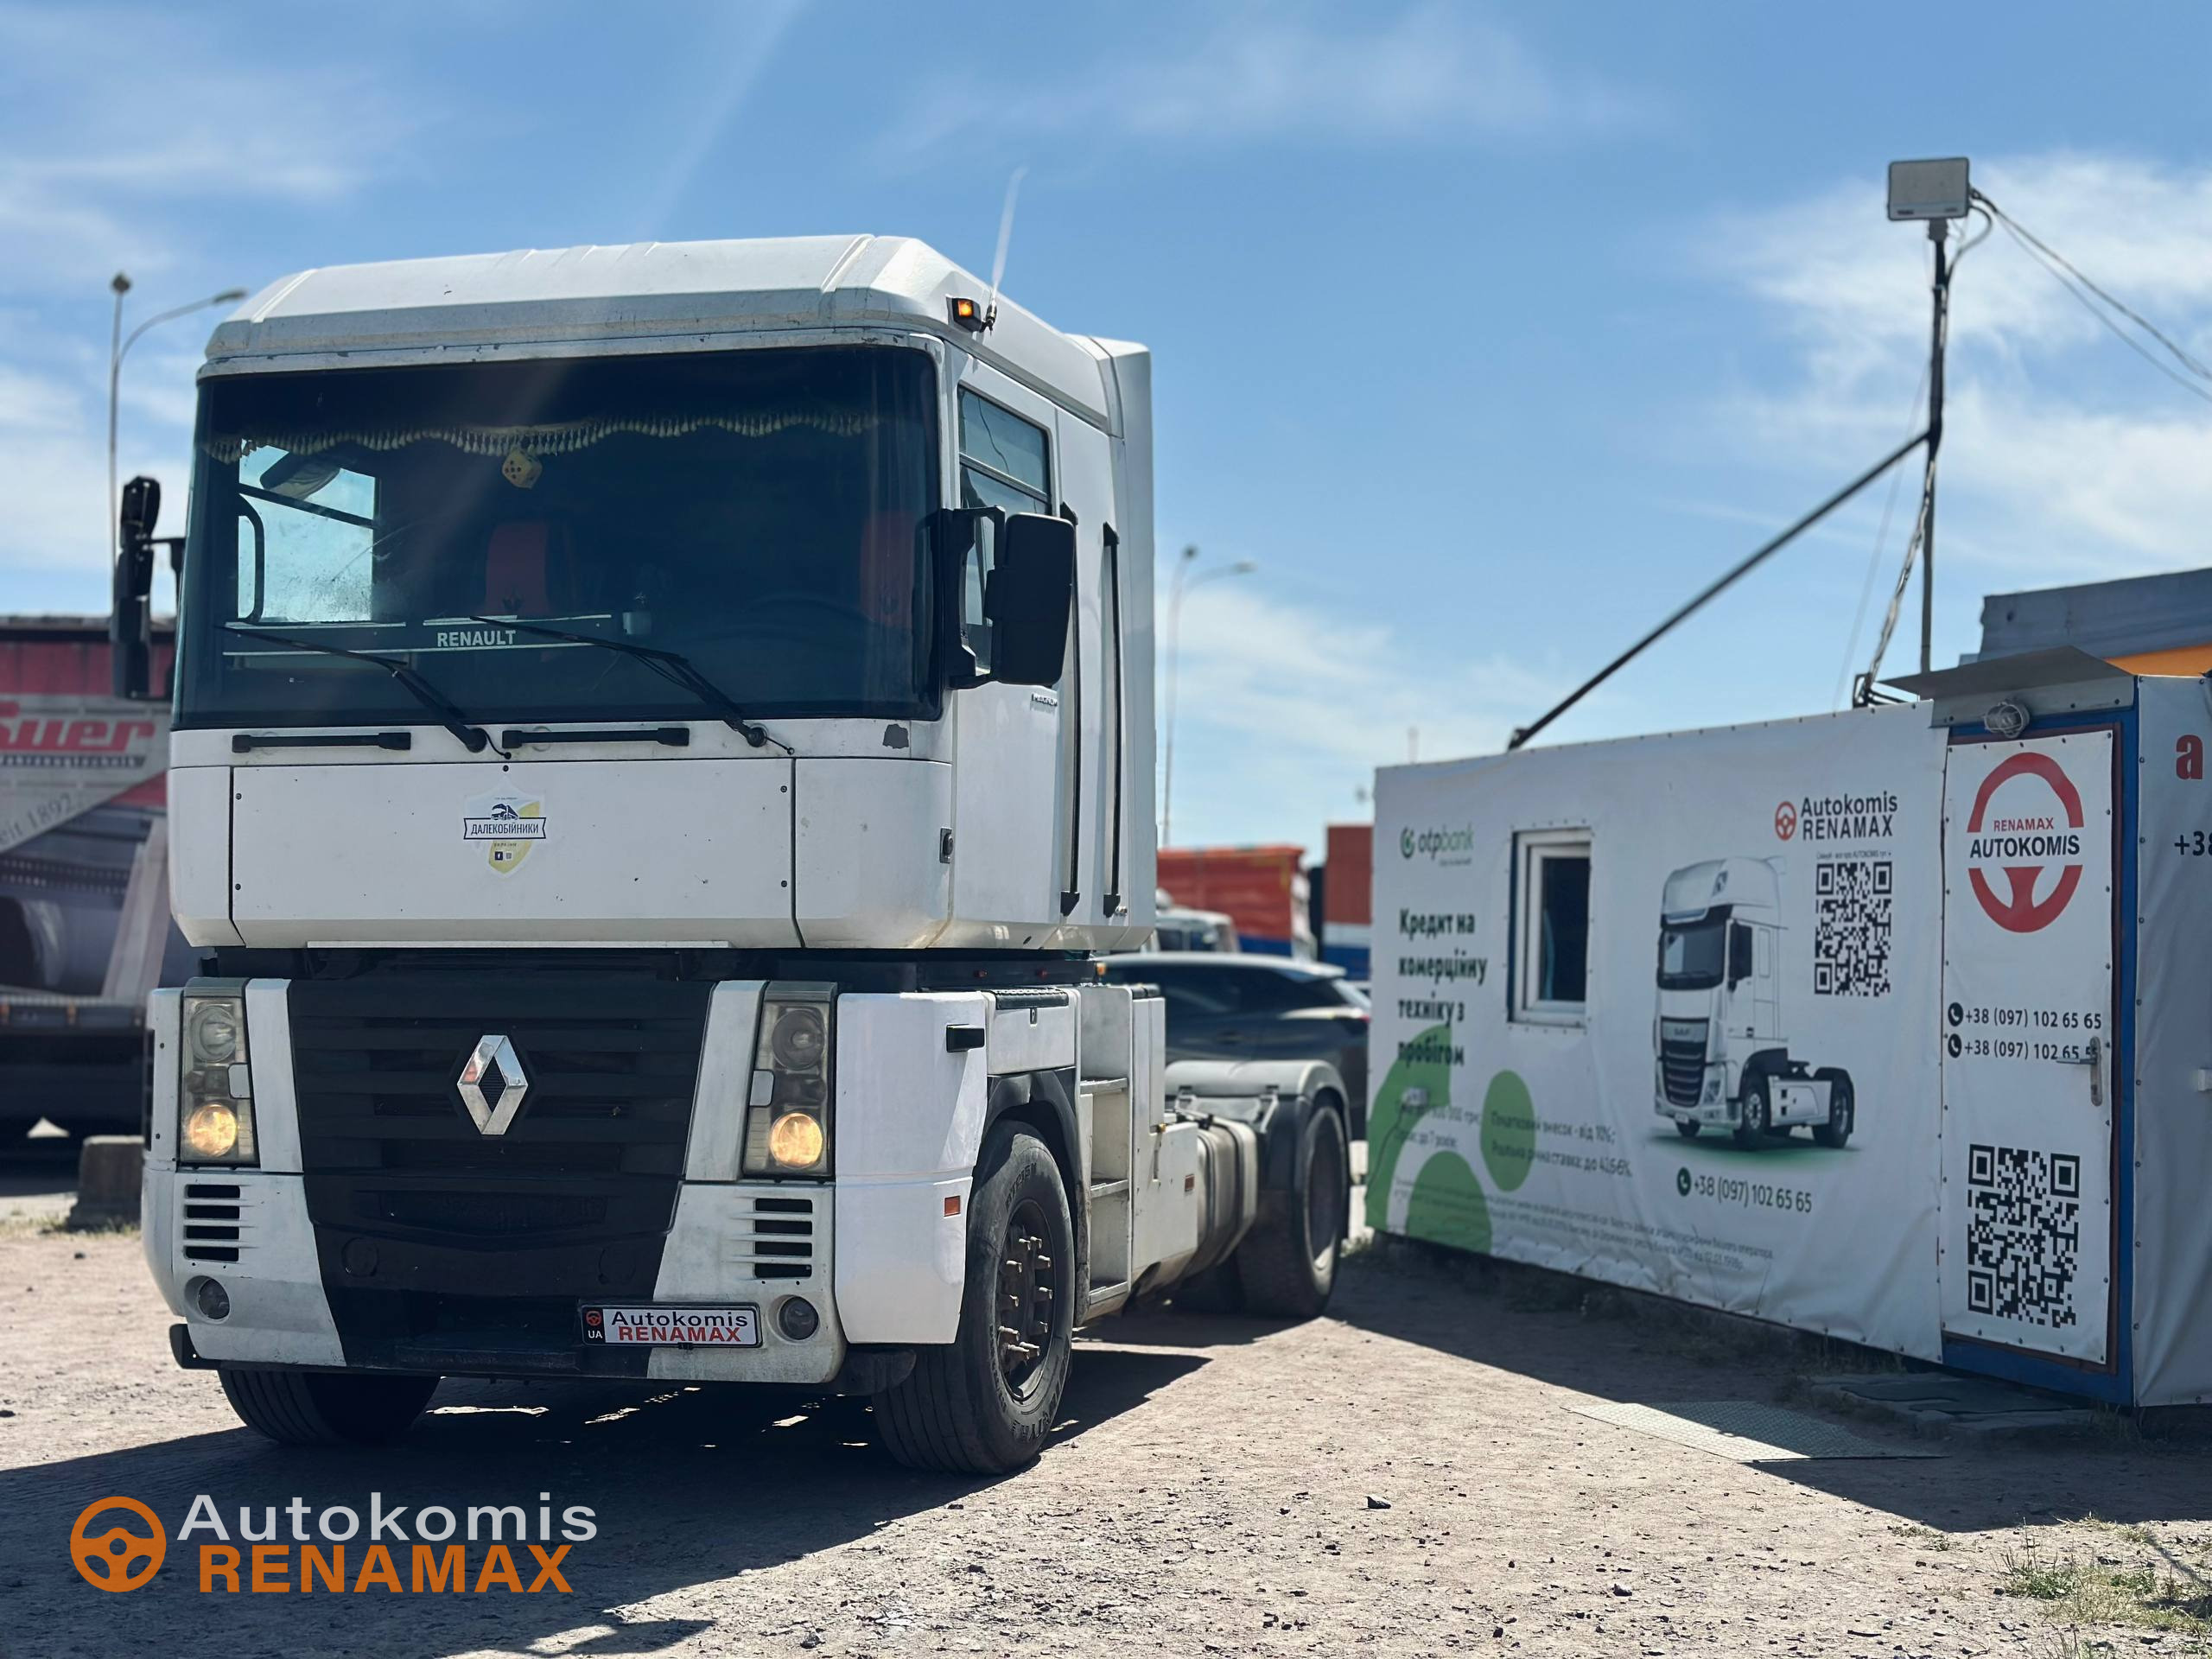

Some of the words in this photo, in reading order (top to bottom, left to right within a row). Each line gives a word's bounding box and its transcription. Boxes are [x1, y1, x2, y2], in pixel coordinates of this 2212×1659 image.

[437, 630, 516, 647] RENAULT
[1801, 791, 1897, 817] Autokomis
[471, 822, 539, 836] ДАЛЕКОБІЙНИКИ
[1802, 815, 1893, 841] RENAMAX
[1993, 817, 2054, 832] RENAMAX
[1970, 835, 2080, 858] AUTOKOMIS
[1399, 908, 1453, 941] Кредит
[1457, 913, 1475, 934] на
[1398, 948, 1487, 986] комерційну
[1398, 991, 1454, 1028] техніку
[1457, 1001, 1465, 1022] з
[1966, 1007, 1989, 1024] +38
[1994, 1007, 2028, 1027] (097)
[2033, 1011, 2058, 1027] 102
[2063, 1012, 2079, 1028] 65
[2084, 1014, 2101, 1029] 65
[1398, 1035, 1465, 1067] пробігом
[1965, 1039, 1989, 1055] +38
[1994, 1039, 2029, 1059] (097)
[2034, 1044, 2058, 1059] 102
[2063, 1045, 2079, 1058] 65
[1694, 1175, 1715, 1197] +38
[1718, 1177, 1749, 1209] (097)
[1752, 1184, 1773, 1206] 102
[1776, 1188, 1793, 1210] 65
[1796, 1191, 1812, 1213] 65
[612, 1311, 747, 1326] Autokomis
[588, 1330, 603, 1339] UA
[619, 1326, 741, 1342] RENAMAX
